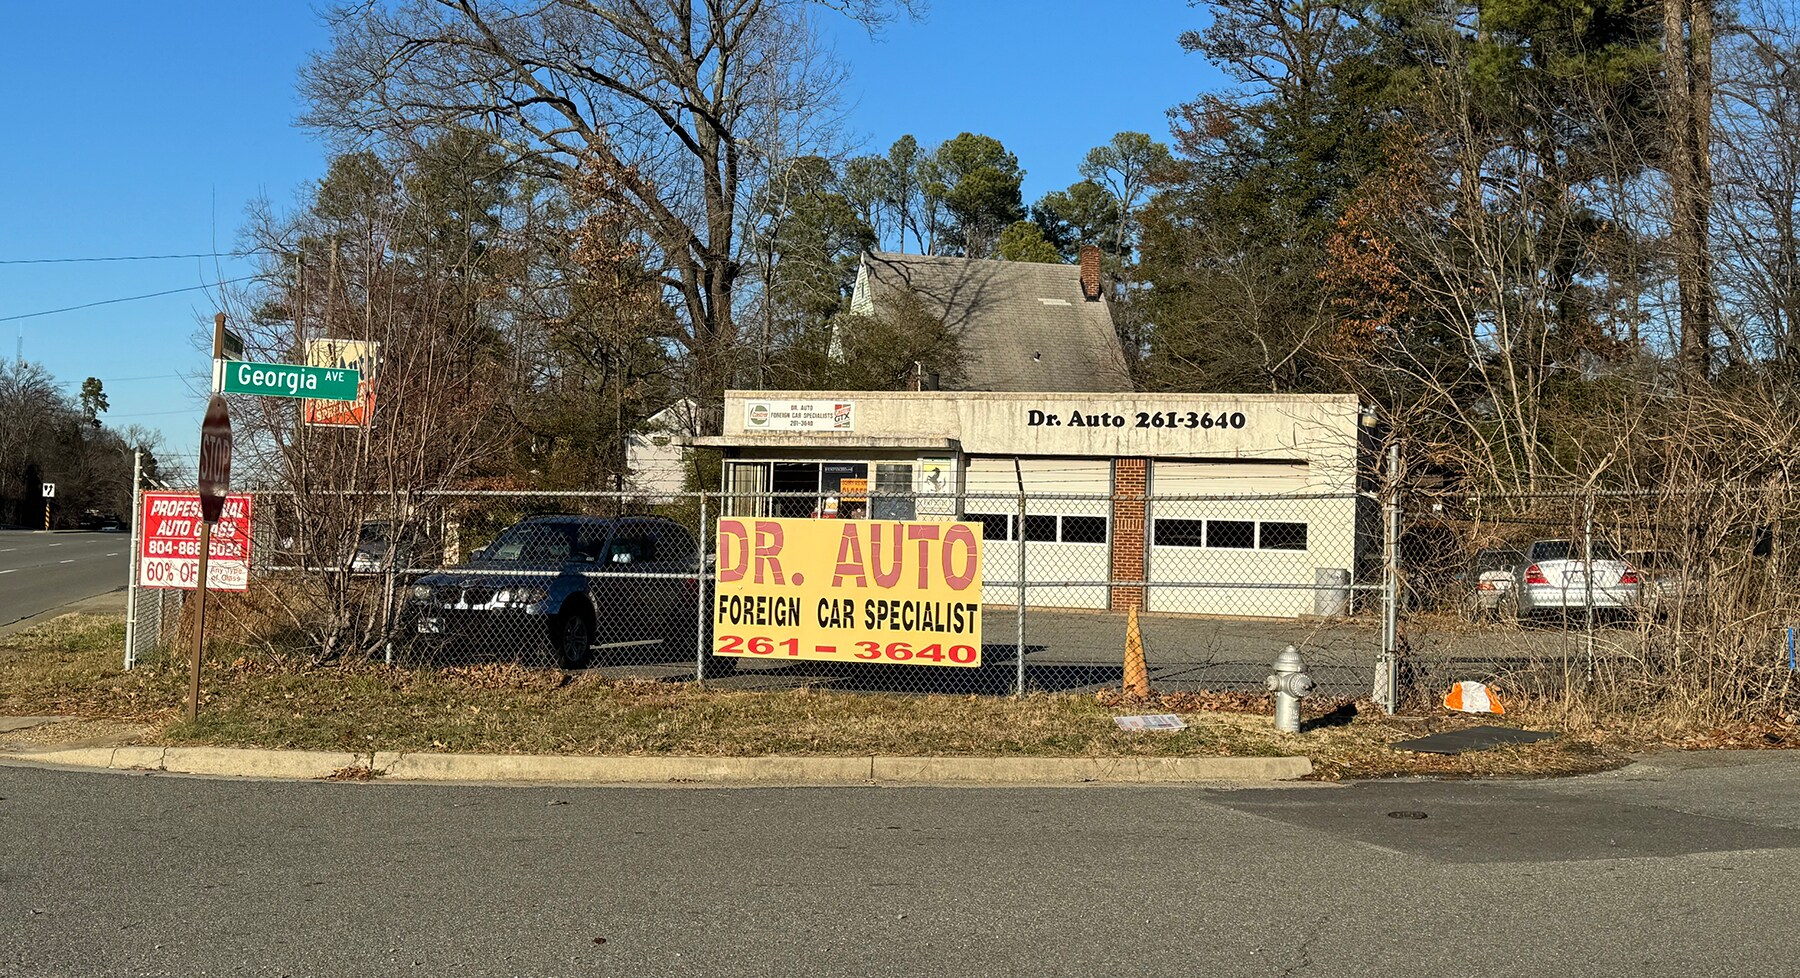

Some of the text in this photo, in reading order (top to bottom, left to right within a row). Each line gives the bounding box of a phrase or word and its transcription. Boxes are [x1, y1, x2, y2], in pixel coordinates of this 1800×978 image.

[238, 364, 317, 395] Georgia
[325, 371, 344, 382] AVE
[834, 412, 850, 422] GTX
[1027, 410, 1246, 429] Dr. Auto 261-3640
[201, 433, 230, 483] STOP
[156, 519, 236, 538] AUTO GASS
[720, 520, 978, 591] DR. AUTO
[147, 561, 199, 582] 60% OF
[718, 595, 978, 634] FOREIGN CAR SPECIALIST
[718, 635, 799, 657] 261
[853, 641, 978, 664] 3640
